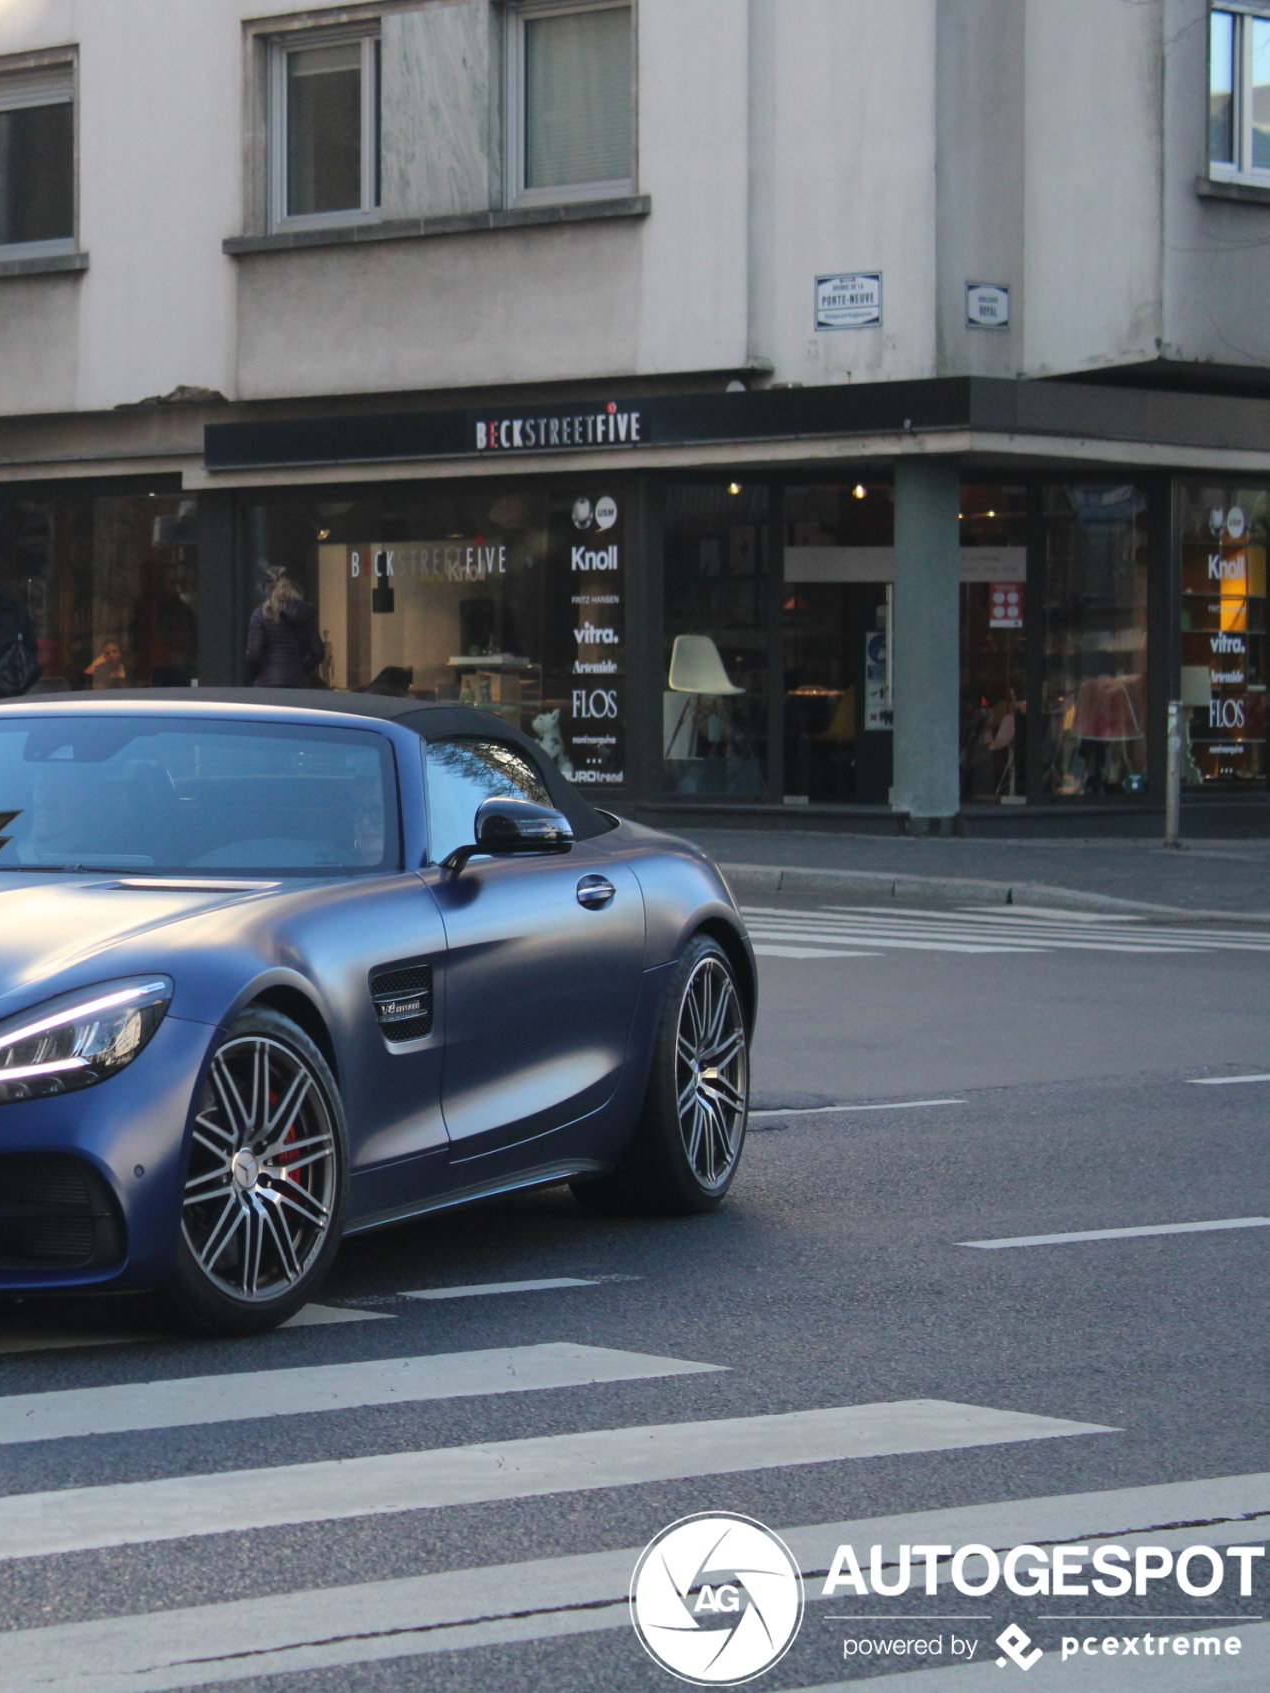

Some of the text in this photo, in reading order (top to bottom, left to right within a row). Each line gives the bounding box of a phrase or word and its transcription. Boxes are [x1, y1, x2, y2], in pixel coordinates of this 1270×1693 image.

[822, 293, 874, 307] PORTE-NEUVE
[979, 305, 998, 318] ROYAL
[476, 411, 640, 449] BECKSTREETFIVE
[598, 508, 614, 517] USM
[571, 545, 618, 571] Knoll
[1208, 554, 1246, 579] Knoll
[591, 595, 620, 604] HANSEN
[572, 660, 618, 674] Artemide
[572, 689, 618, 718] FLOS
[1209, 699, 1245, 728] FLOS
